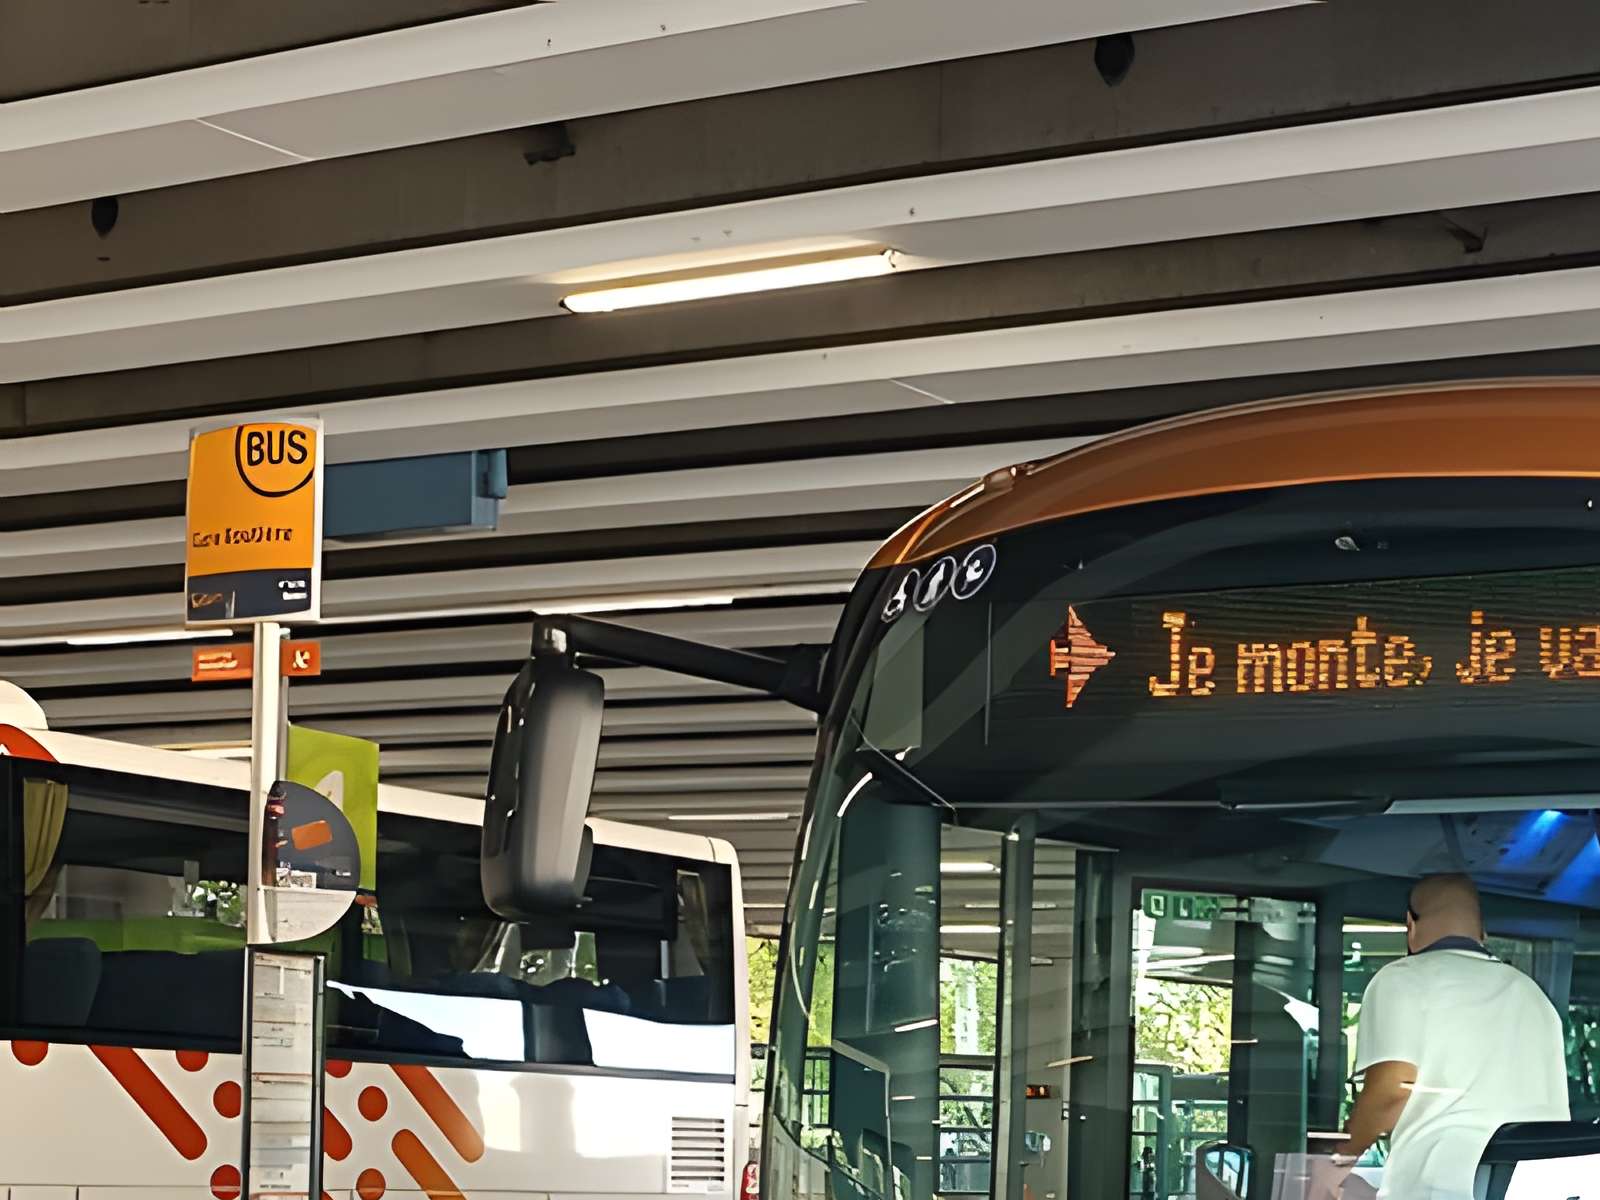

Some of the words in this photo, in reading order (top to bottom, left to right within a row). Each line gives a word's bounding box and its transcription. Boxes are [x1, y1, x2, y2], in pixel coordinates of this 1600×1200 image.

[246, 430, 307, 466] BUS
[1149, 611, 1215, 696] Je
[1455, 609, 1516, 684] je
